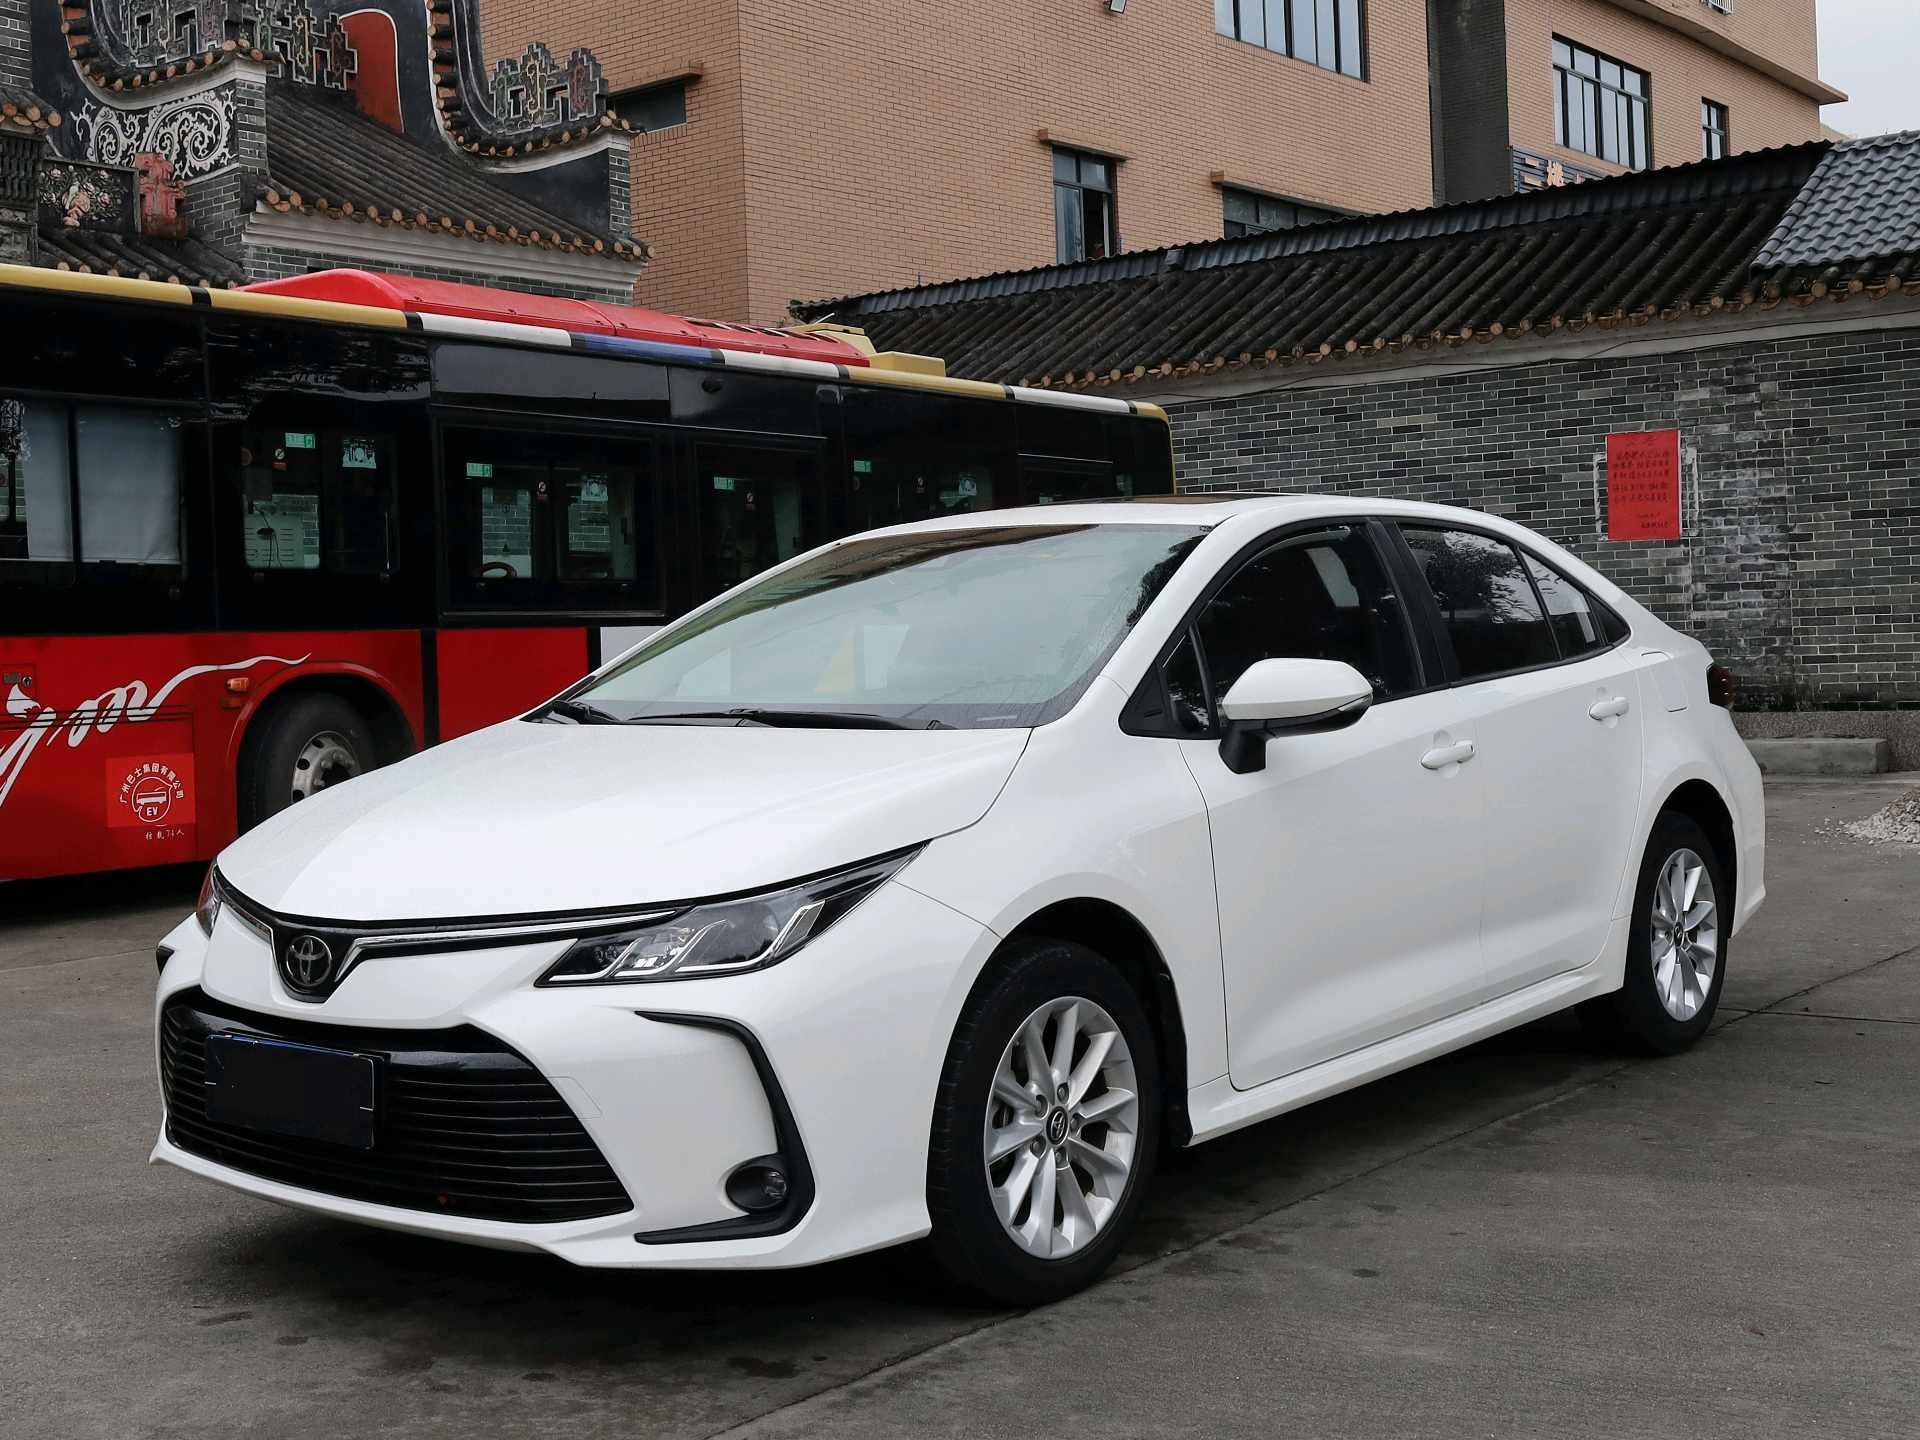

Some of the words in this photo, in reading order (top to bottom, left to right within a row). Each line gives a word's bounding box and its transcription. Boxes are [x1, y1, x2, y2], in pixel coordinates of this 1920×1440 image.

[120, 763, 184, 803] 广州巴士集团有限公司
[147, 807, 158, 816] EV
